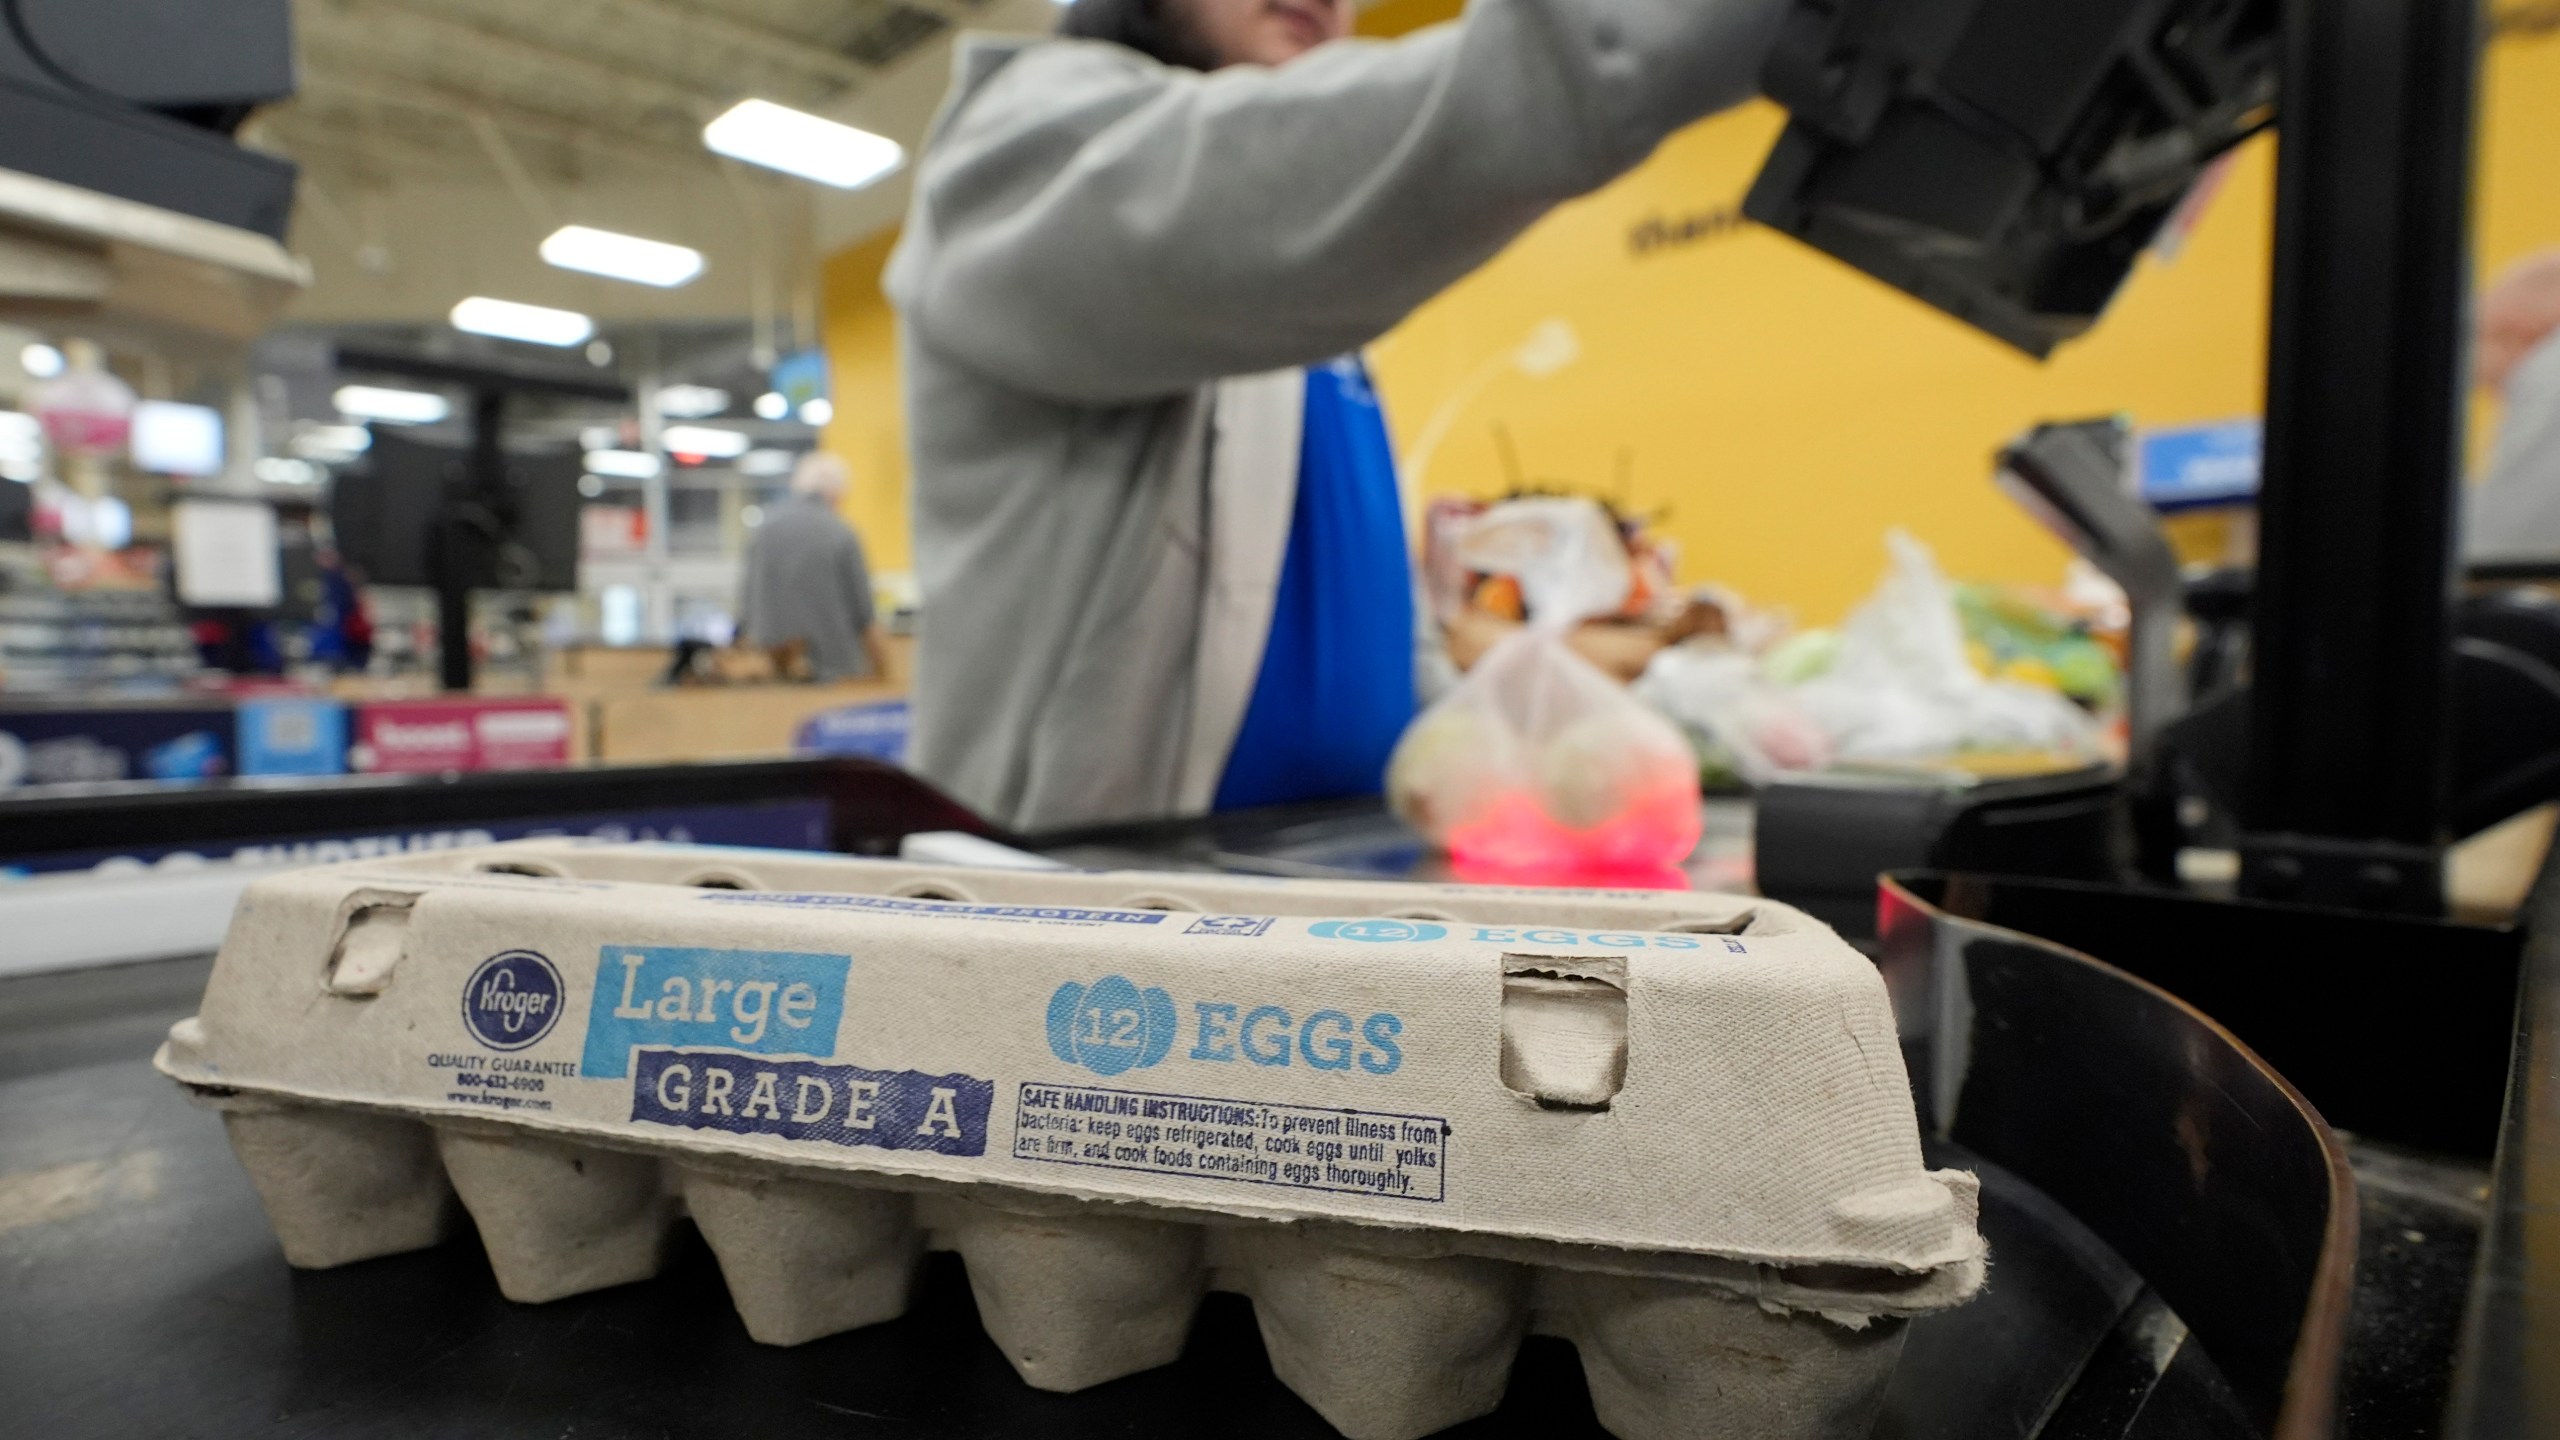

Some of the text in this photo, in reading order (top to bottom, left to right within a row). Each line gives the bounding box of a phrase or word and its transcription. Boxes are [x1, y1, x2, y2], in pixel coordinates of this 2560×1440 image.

[993, 906, 1148, 923] PROTEIN
[1347, 926, 1409, 938] 12
[1469, 927, 1701, 950] EGGS
[479, 968, 551, 1032] Kroger
[614, 954, 818, 1045] Large
[427, 1053, 577, 1077] QUALITY GUARANTEE
[1082, 1000, 1405, 1075] 12 EGGS
[447, 1088, 552, 1110] www.kroger.com
[457, 1072, 545, 1092] 800-632-6900
[657, 1062, 963, 1140] GRADE A
[1021, 1110, 1437, 1168] bacteria: keep eggs refrigerated, cook eggs until yolks
[1023, 1088, 1060, 1109] SAFE
[1064, 1092, 1139, 1116] HANDLING
[1282, 1115, 1340, 1135] prevent
[1345, 1117, 1396, 1140] illness
[1401, 1122, 1437, 1144] from
[1019, 1135, 1414, 1195] are firm, and cook foods containing eggs thoroughly.
